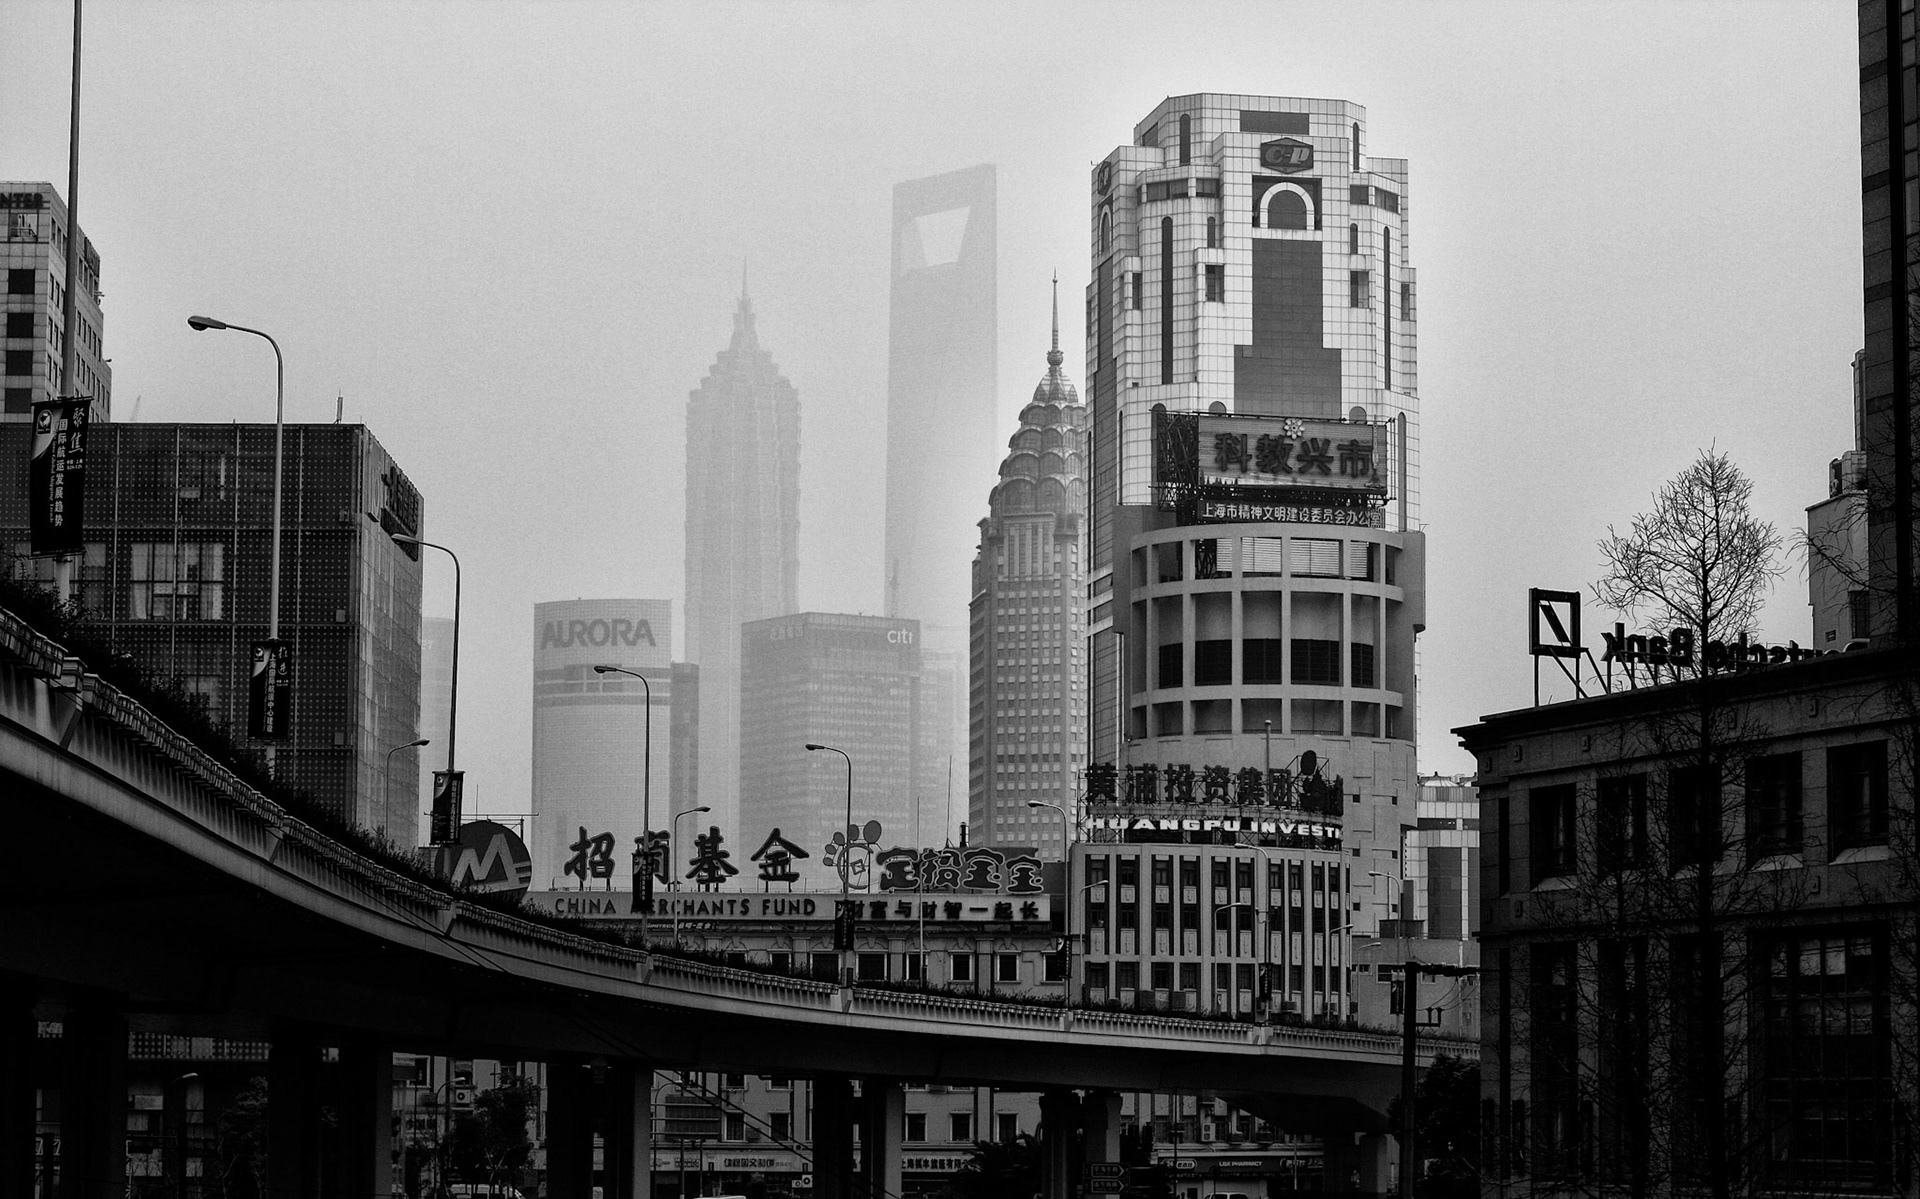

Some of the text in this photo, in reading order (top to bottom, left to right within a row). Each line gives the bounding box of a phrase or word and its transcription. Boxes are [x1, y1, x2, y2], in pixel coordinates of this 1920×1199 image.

[1215, 432, 1373, 478] 科教兴市
[54, 418, 69, 527] 国际航运发展趋势
[1202, 502, 1381, 529] 上海市精神文明建设委员会办公室
[540, 618, 656, 649] AURORA
[887, 628, 912, 644] citi
[1085, 762, 1292, 806] 黄浦投资集团
[1087, 817, 1241, 833] HUANGPU
[554, 898, 616, 914] CHINA
[762, 898, 816, 916] FUND
